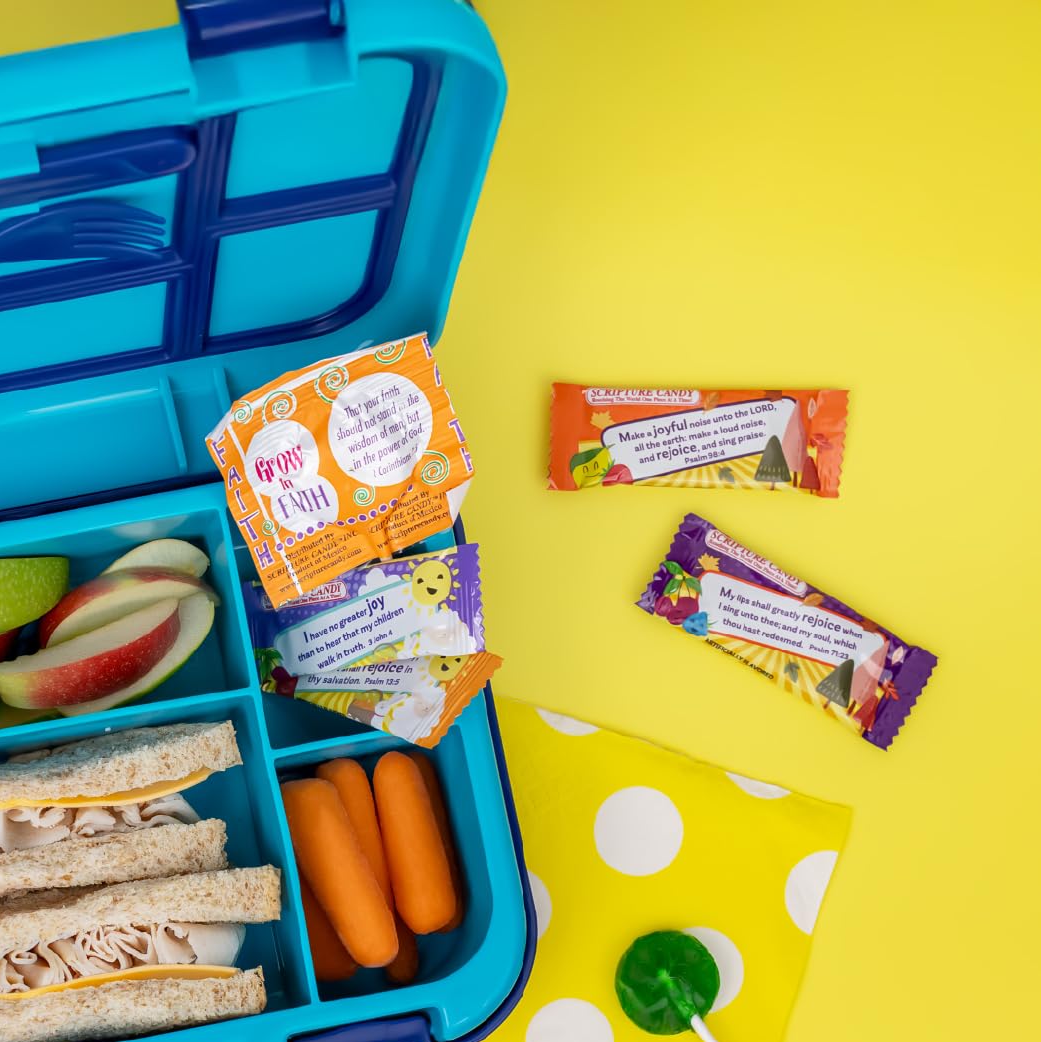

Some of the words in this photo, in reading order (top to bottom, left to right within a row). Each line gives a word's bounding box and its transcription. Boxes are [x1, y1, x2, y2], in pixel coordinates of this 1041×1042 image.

[618, 431, 645, 443] Make
[652, 418, 688, 439] joyful
[689, 418, 711, 428] noise
[712, 413, 733, 423] unto
[734, 409, 748, 418] the
[749, 403, 777, 415] LORD,
[277, 484, 331, 519] FAITH
[297, 649, 315, 662] than
[324, 636, 341, 650] hear
[342, 628, 360, 641] that
[360, 622, 373, 634] my
[373, 607, 404, 627] children
[303, 631, 309, 643] I
[309, 628, 331, 641] have
[328, 622, 343, 632] no
[339, 608, 370, 629] greater
[366, 595, 385, 617] joy
[718, 601, 722, 609] I
[722, 604, 740, 617] sing
[740, 610, 759, 621] unto
[760, 616, 781, 629] thee;
[781, 624, 798, 634] and
[798, 629, 813, 638] my
[813, 633, 832, 644] soul,
[833, 638, 857, 650] which
[317, 654, 336, 669] walk
[335, 652, 343, 660] in
[343, 642, 366, 656] truth.
